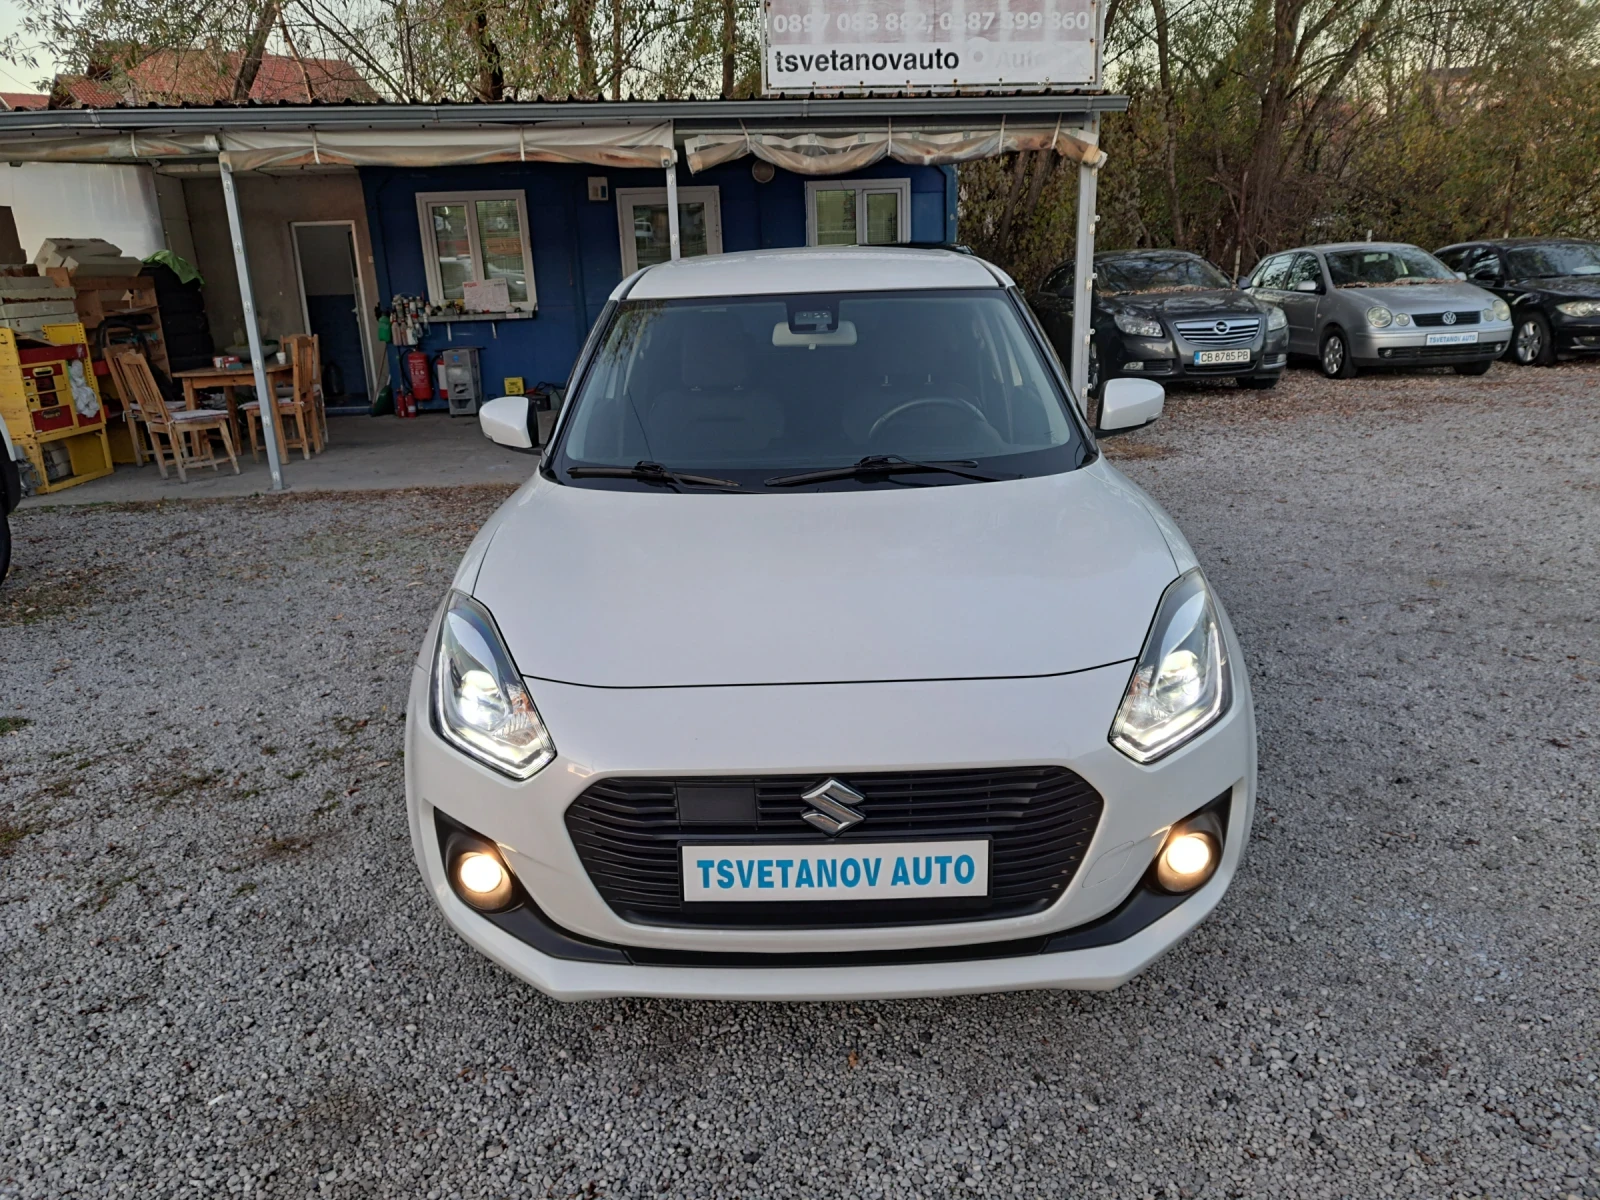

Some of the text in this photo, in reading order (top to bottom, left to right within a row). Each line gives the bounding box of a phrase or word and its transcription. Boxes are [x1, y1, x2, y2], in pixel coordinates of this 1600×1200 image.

[837, 13, 879, 32] 083
[939, 11, 995, 31] 087
[775, 48, 960, 73] tsvetanovauto
[1430, 335, 1461, 343] TSVETANOV
[1201, 350, 1249, 363] CB 8785 PB
[696, 854, 975, 889] TSVETANOV AUTO
